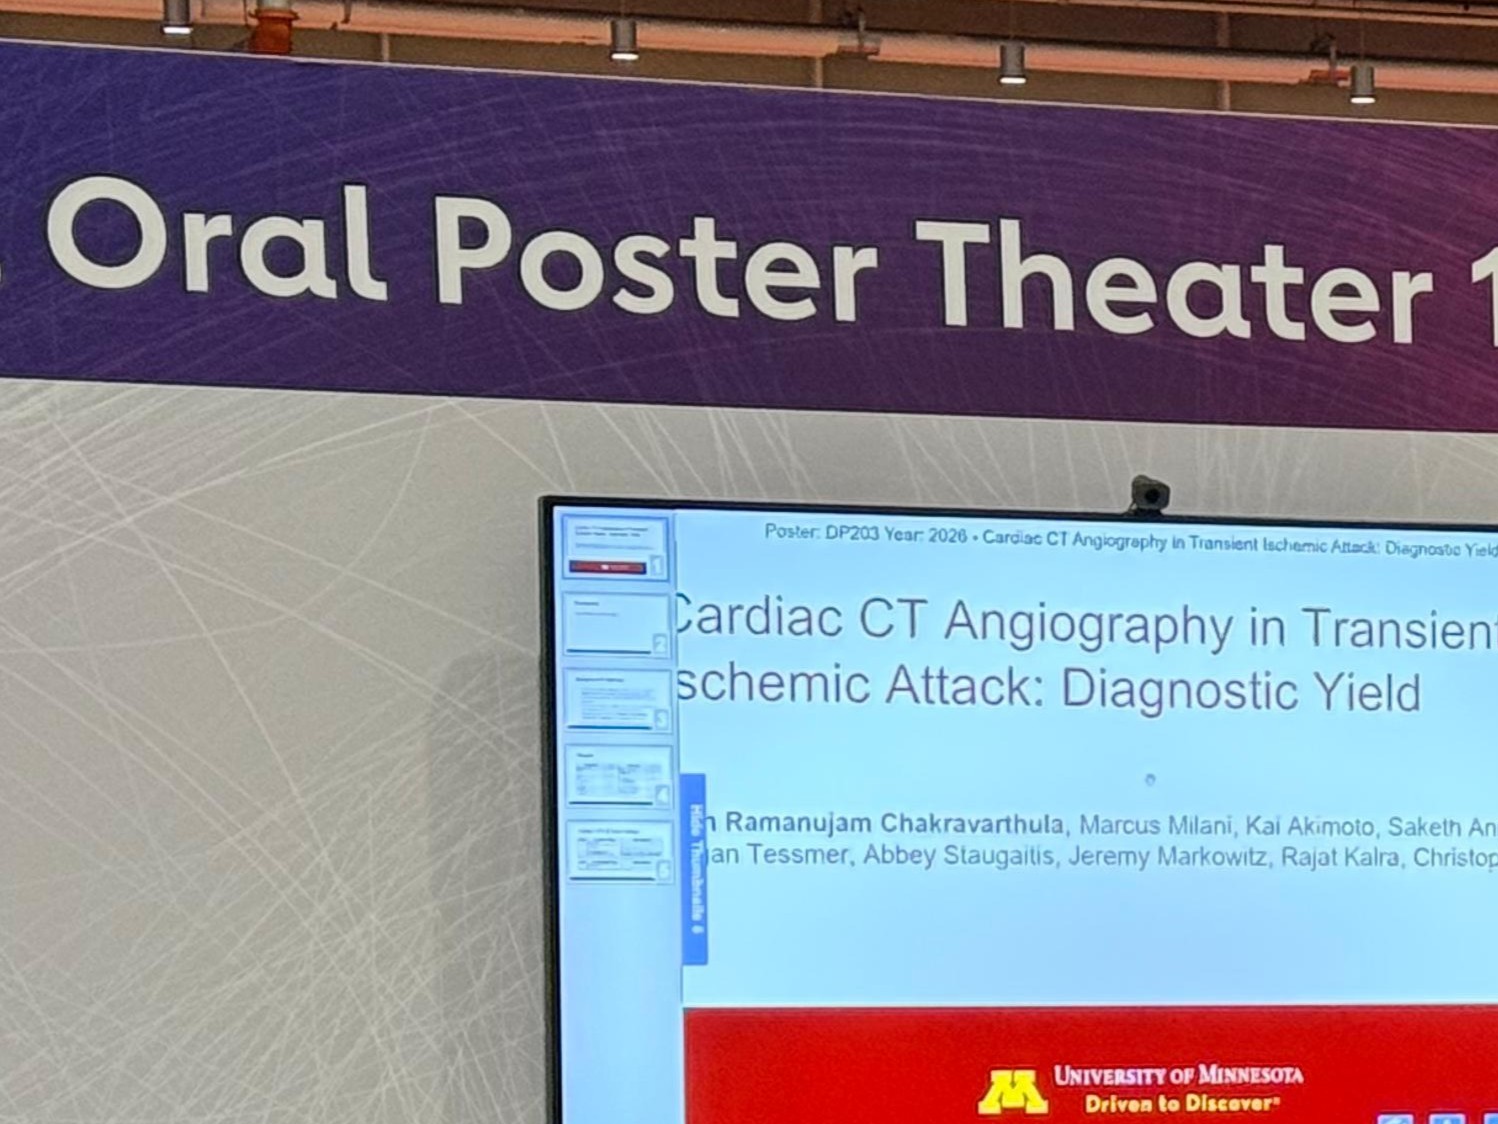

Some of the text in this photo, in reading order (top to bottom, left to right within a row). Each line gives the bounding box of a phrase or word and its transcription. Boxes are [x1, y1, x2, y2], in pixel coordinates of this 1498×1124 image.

[47, 175, 388, 301] Oral
[435, 195, 878, 322] Poster
[915, 219, 1433, 345] Theater
[825, 525, 880, 541] DP203
[983, 529, 1042, 546] Cardiac
[1047, 531, 1067, 546] CT
[1072, 532, 1168, 552] Angiography
[1172, 535, 1185, 550] in
[1189, 535, 1258, 552] Transient
[1263, 537, 1327, 553] Ischemic
[1385, 540, 1461, 558] Diagnostic
[860, 598, 928, 639] CT
[944, 599, 1234, 655] Angiography
[1250, 606, 1285, 647] in
[676, 661, 870, 704] schemic
[886, 664, 1044, 707] Attack:
[1063, 667, 1299, 719] Diagnostic
[1314, 671, 1421, 713] Yield
[726, 811, 872, 838] Ramanujam
[881, 812, 1070, 837] Chakravarthula,
[1080, 815, 1161, 836] Marcus
[1169, 815, 1238, 839] Milani,
[1246, 817, 1280, 836] Kai
[1288, 817, 1380, 840] Akimoto,
[1388, 817, 1461, 837] Saketh
[749, 843, 856, 868] Tessmer,
[864, 844, 936, 870] Abbey
[1069, 845, 1151, 871] Jeremy
[1158, 845, 1273, 869] Markowitz,
[1282, 846, 1337, 871] Rajat
[1345, 846, 1405, 869] Kalra,
[1085, 1095, 1152, 1113] Driven
[1158, 1094, 1180, 1112] to
